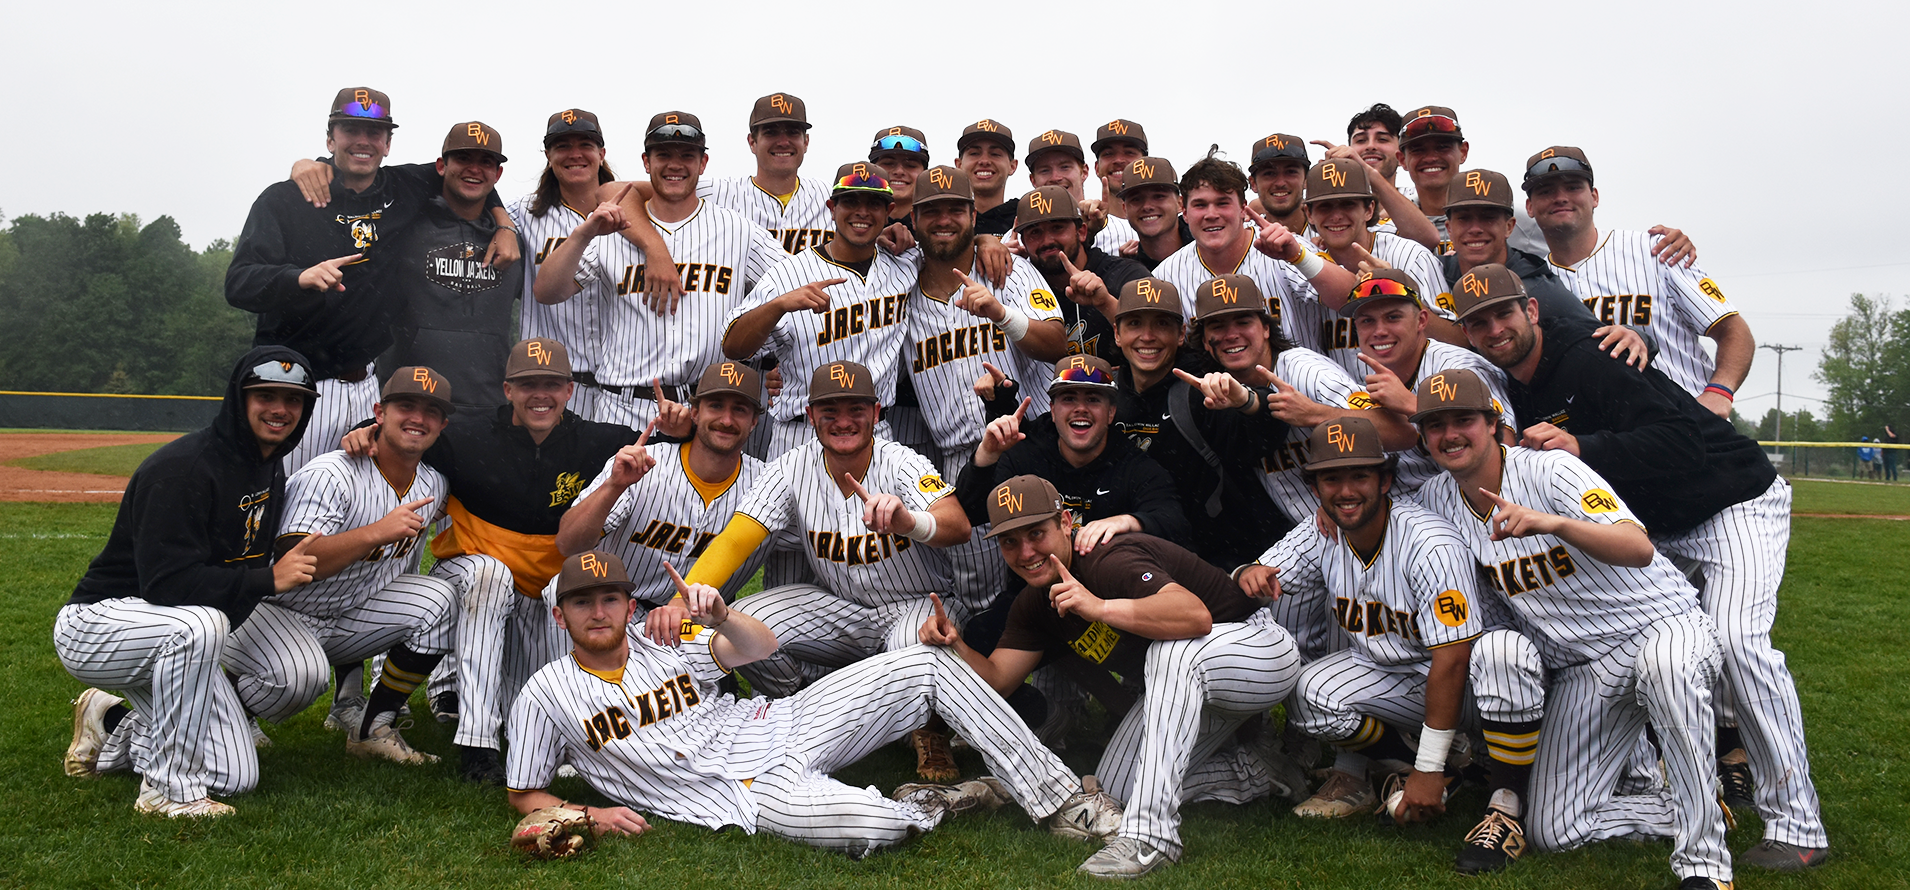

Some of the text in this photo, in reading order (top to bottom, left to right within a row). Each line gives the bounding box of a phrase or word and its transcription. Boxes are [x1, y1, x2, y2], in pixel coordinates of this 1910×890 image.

[435, 257, 464, 278] YELLOW
[913, 322, 1006, 374] JACKETS
[1438, 595, 1467, 622] BW
[583, 673, 700, 753] JACKETS
